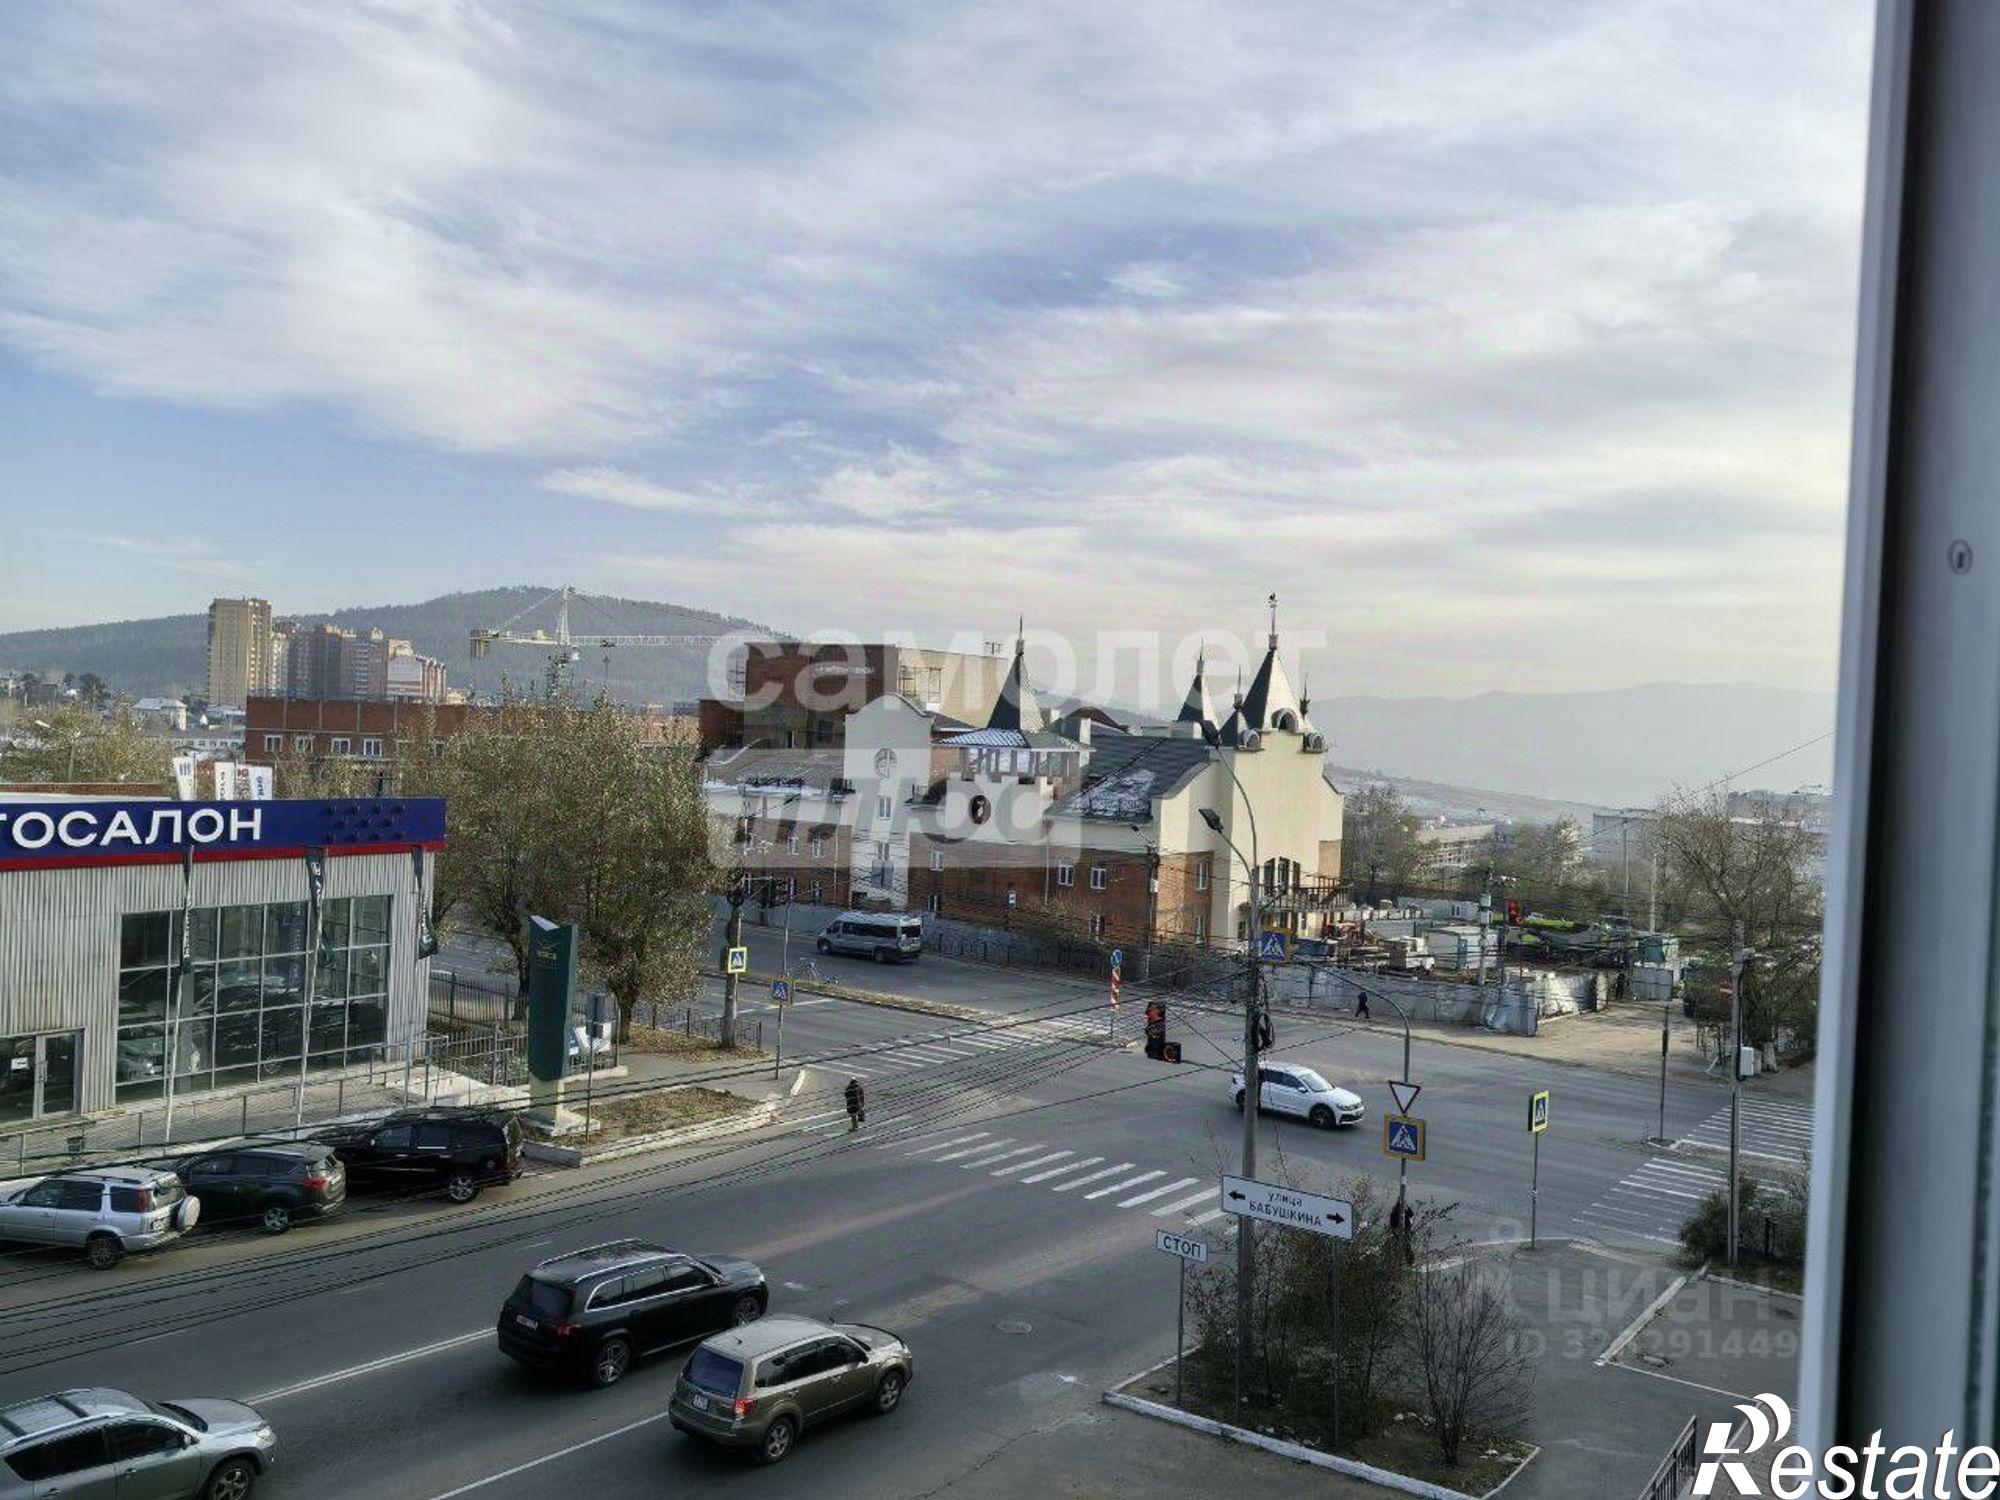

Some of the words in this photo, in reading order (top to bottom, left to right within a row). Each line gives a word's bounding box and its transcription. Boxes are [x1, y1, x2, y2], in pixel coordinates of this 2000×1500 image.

[0, 809, 262, 849] ОСАЛОН
[1249, 1200, 1322, 1226] БАБУШКИНА
[1163, 1236, 1202, 1257] СТОП
